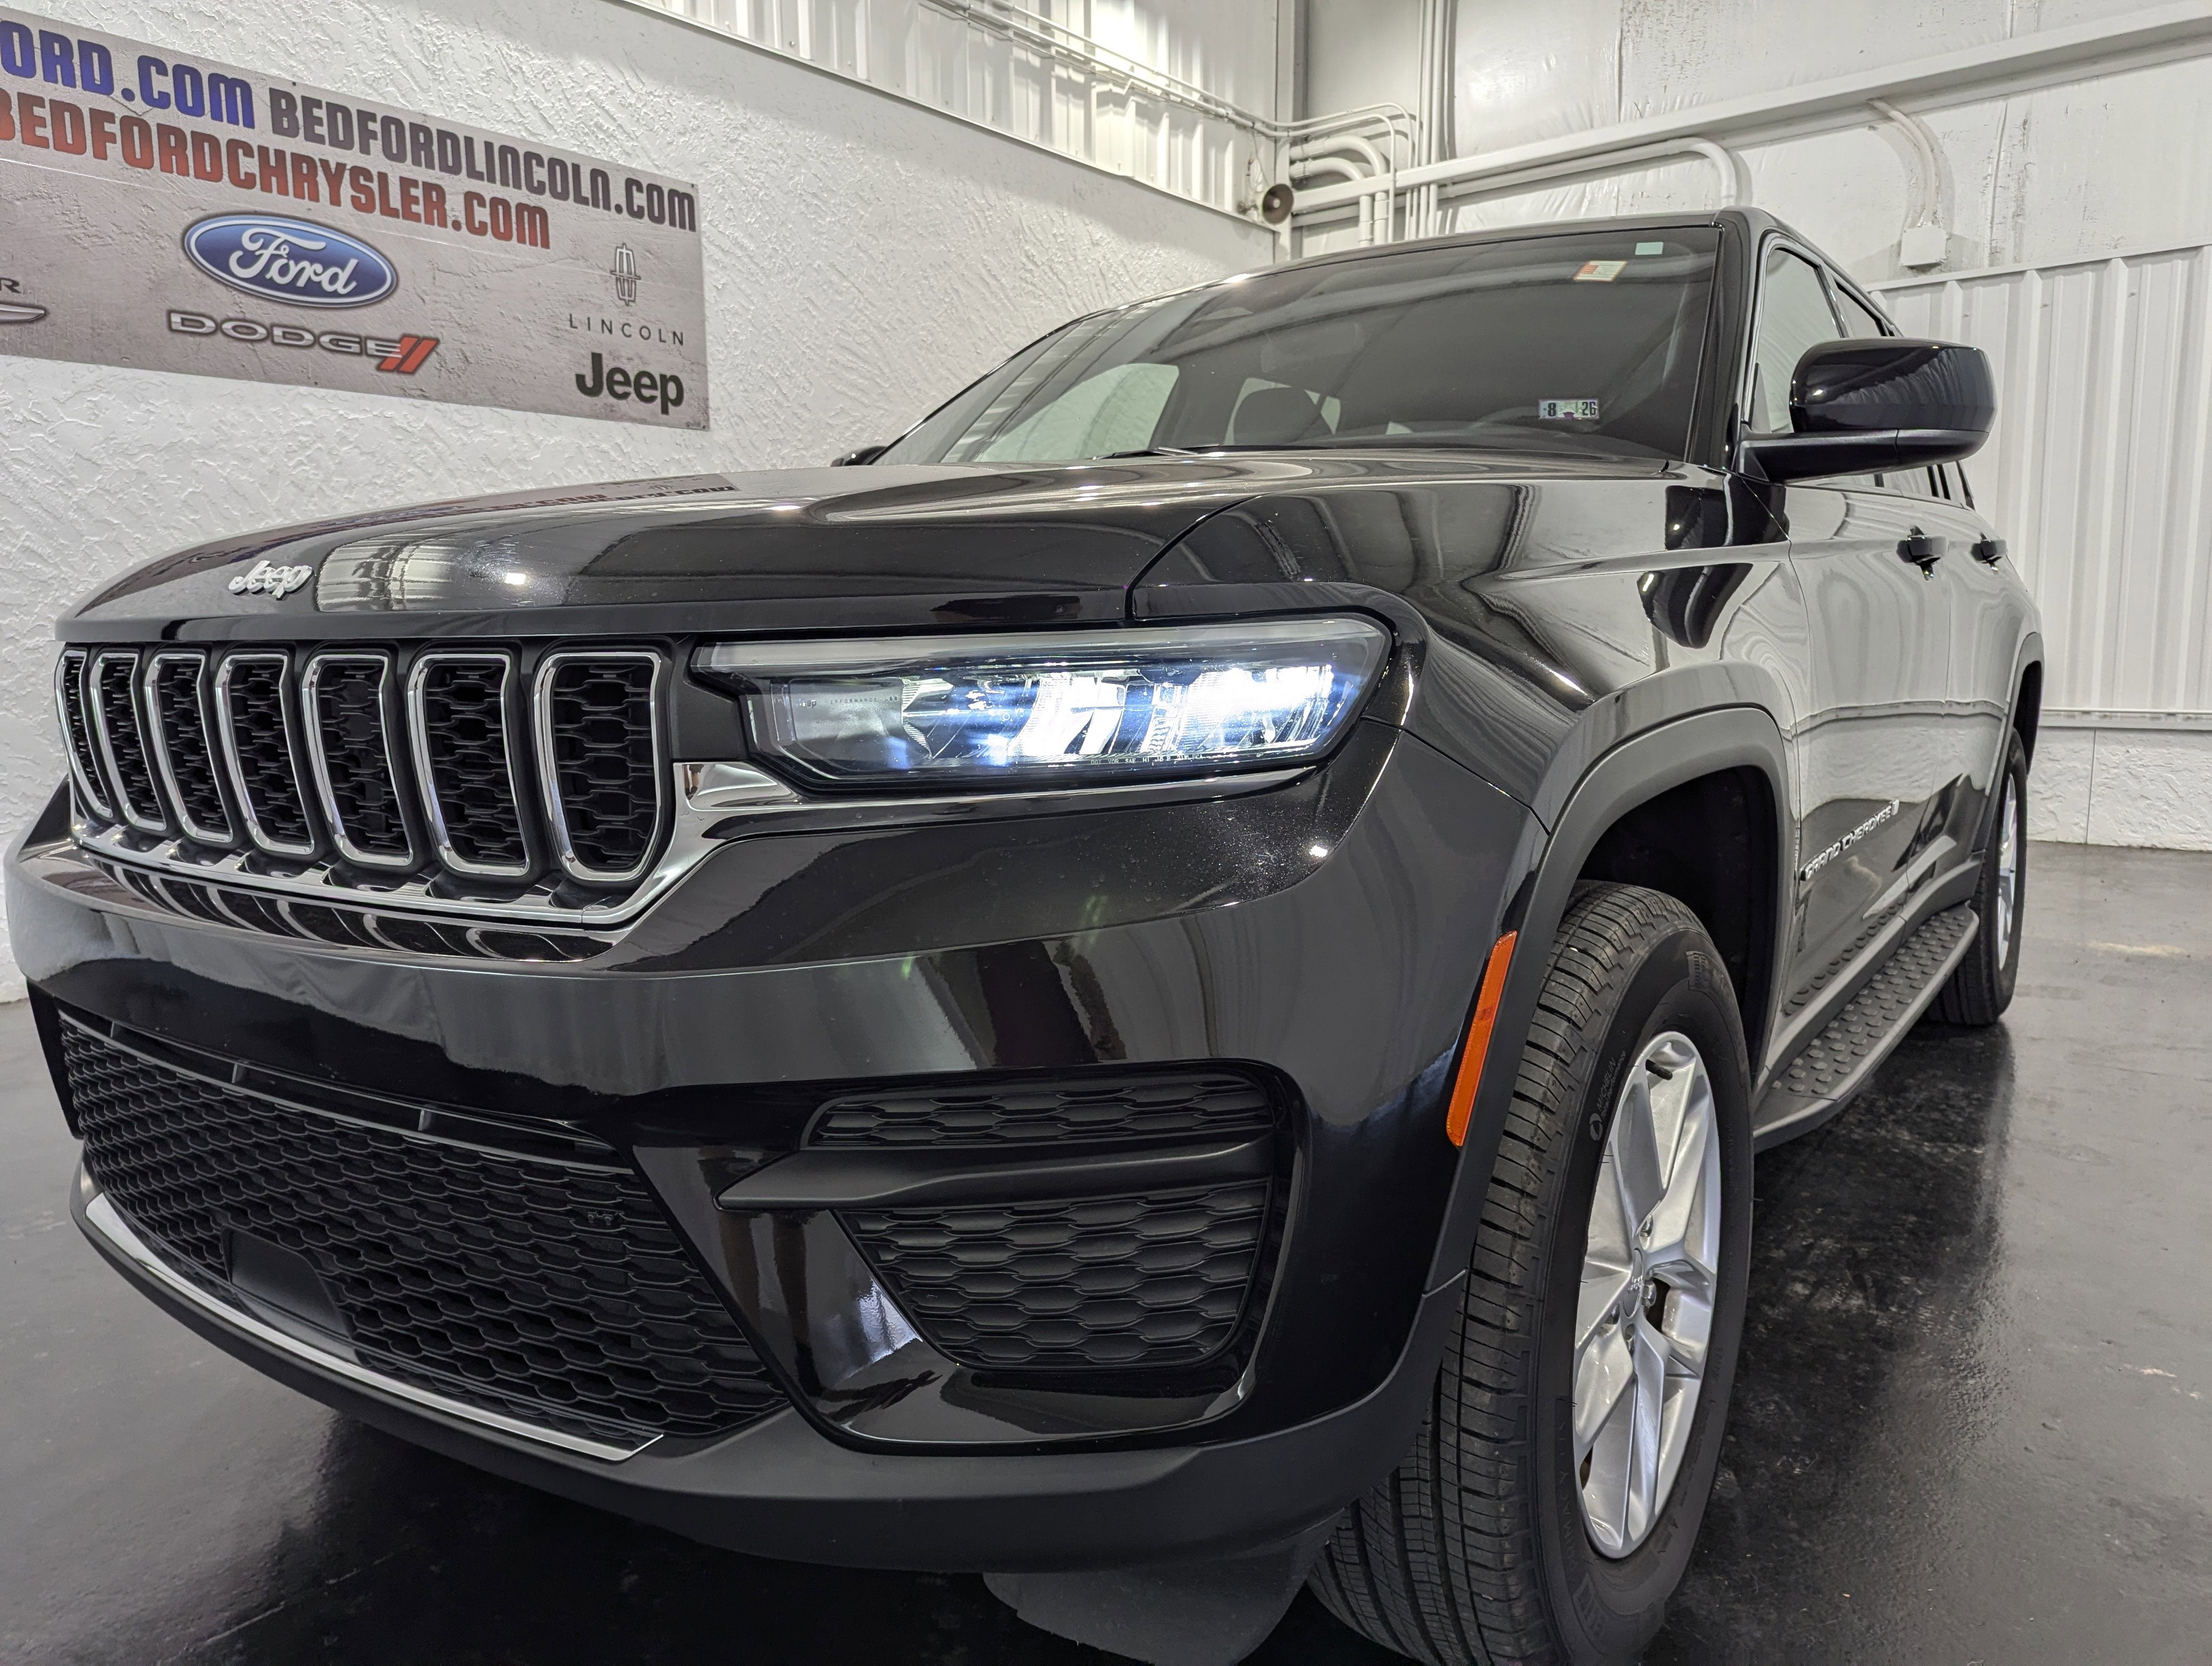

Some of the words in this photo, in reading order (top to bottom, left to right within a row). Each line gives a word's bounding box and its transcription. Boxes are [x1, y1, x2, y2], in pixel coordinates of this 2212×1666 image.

[269, 87, 697, 232] BEDFORDLINCOLN.COM
[228, 227, 359, 296] Ford
[169, 311, 402, 358] DODGE
[569, 313, 684, 346] LINCOLN
[575, 353, 684, 415] Jeep
[1547, 402, 1557, 417] 8
[1581, 401, 1597, 416] 26
[228, 560, 313, 599] Jeep
[1805, 842, 1841, 880] GRAND
[1841, 805, 1892, 851] CHEROKEE
[1596, 1056, 1616, 1111] MICHELIN
